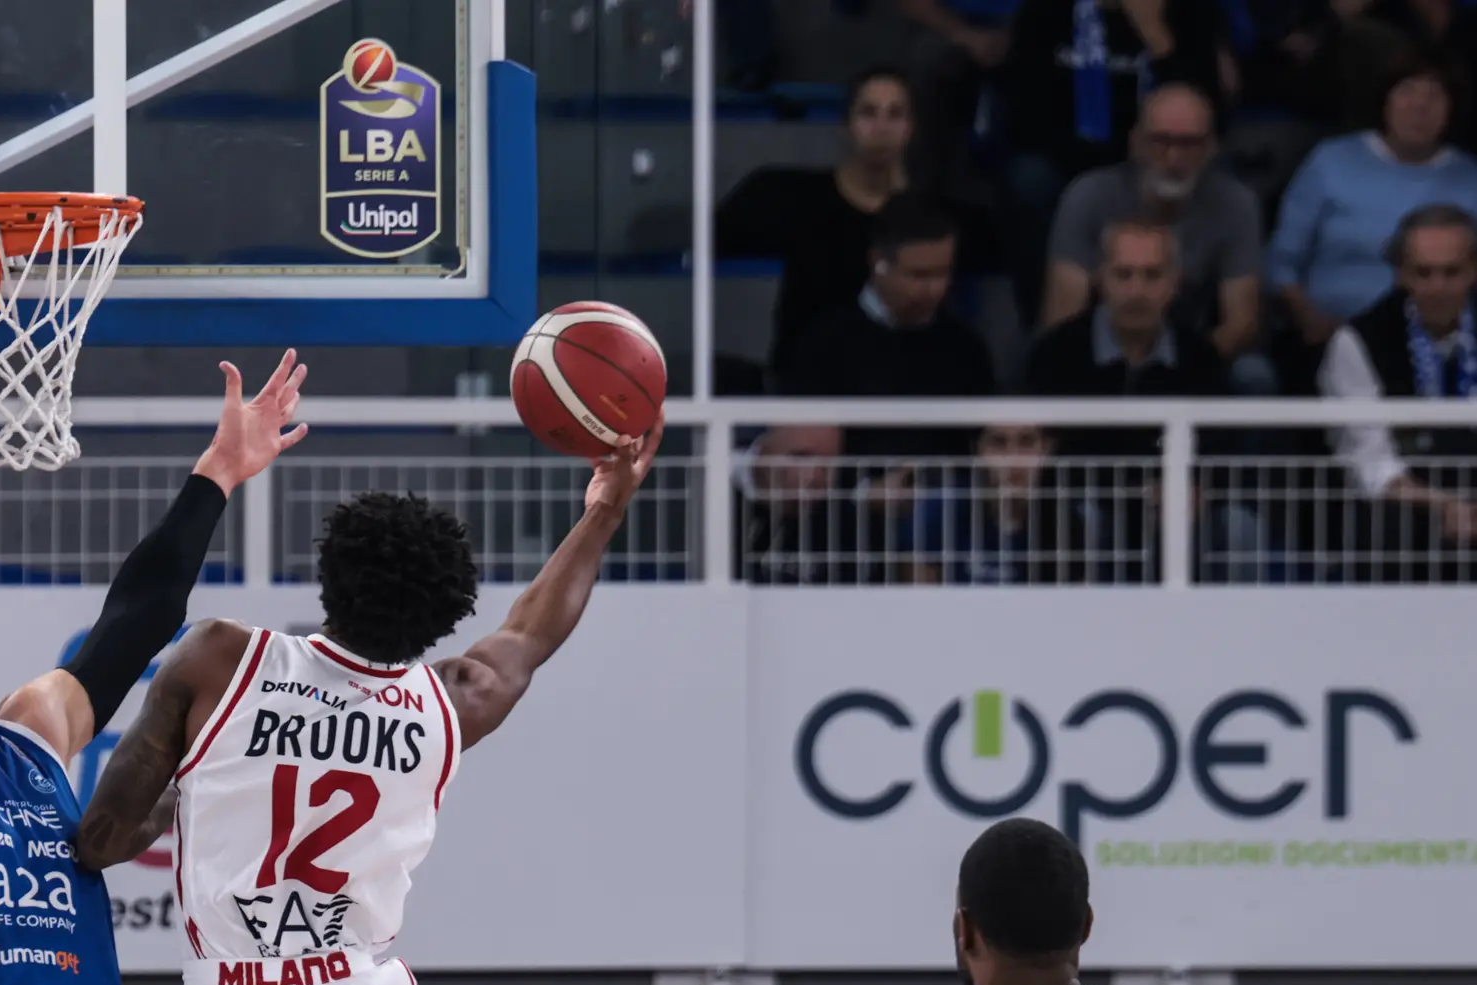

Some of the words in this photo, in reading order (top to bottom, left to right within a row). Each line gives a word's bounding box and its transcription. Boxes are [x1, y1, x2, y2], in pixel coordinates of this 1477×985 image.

[339, 129, 427, 163] LBA
[354, 169, 395, 182] SERIE
[398, 169, 409, 181] A
[348, 201, 418, 235] Unipol
[261, 680, 347, 711] DRIVALIA
[244, 709, 426, 774] BROOKS
[256, 763, 381, 895] 12
[1096, 839, 1275, 867] SOLUZIONI
[16, 914, 76, 934] COMPANY
